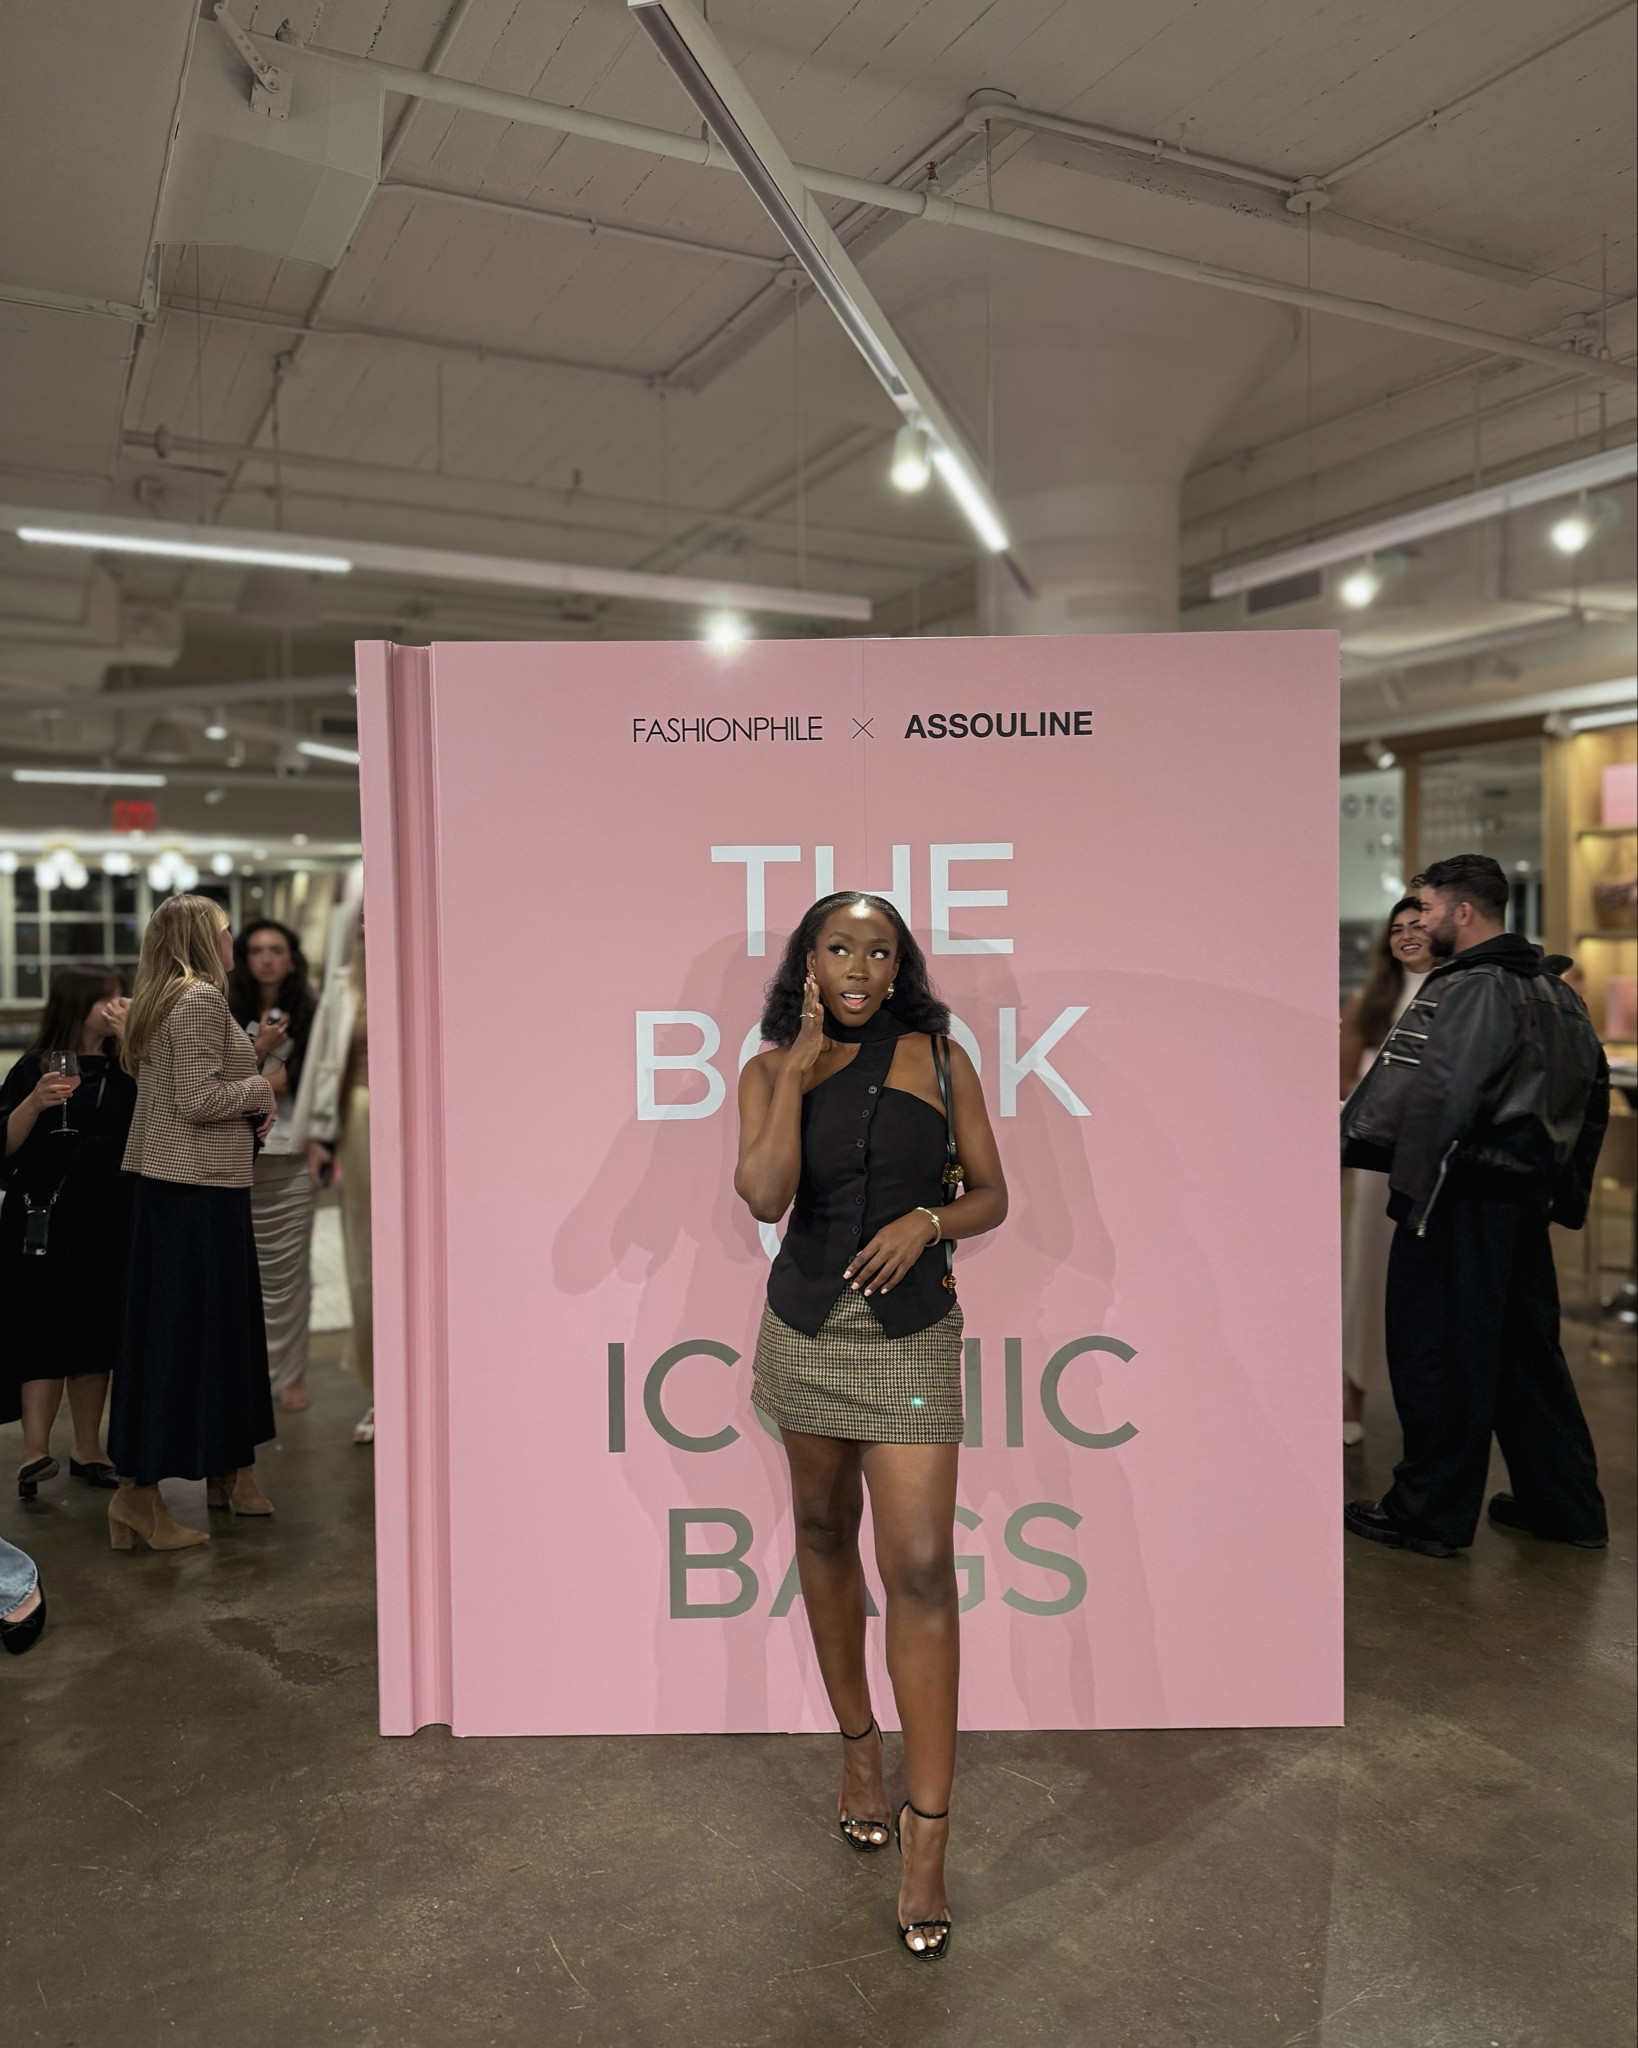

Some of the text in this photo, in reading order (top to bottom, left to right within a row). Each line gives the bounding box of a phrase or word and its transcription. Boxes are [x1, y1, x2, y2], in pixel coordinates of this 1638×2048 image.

[632, 716, 823, 743] FASHIONPHILE
[904, 711, 1094, 739] ASSOULINE
[635, 1006, 1094, 1121] BK
[607, 1335, 1140, 1453] ICIC
[668, 1502, 1088, 1619] BS
